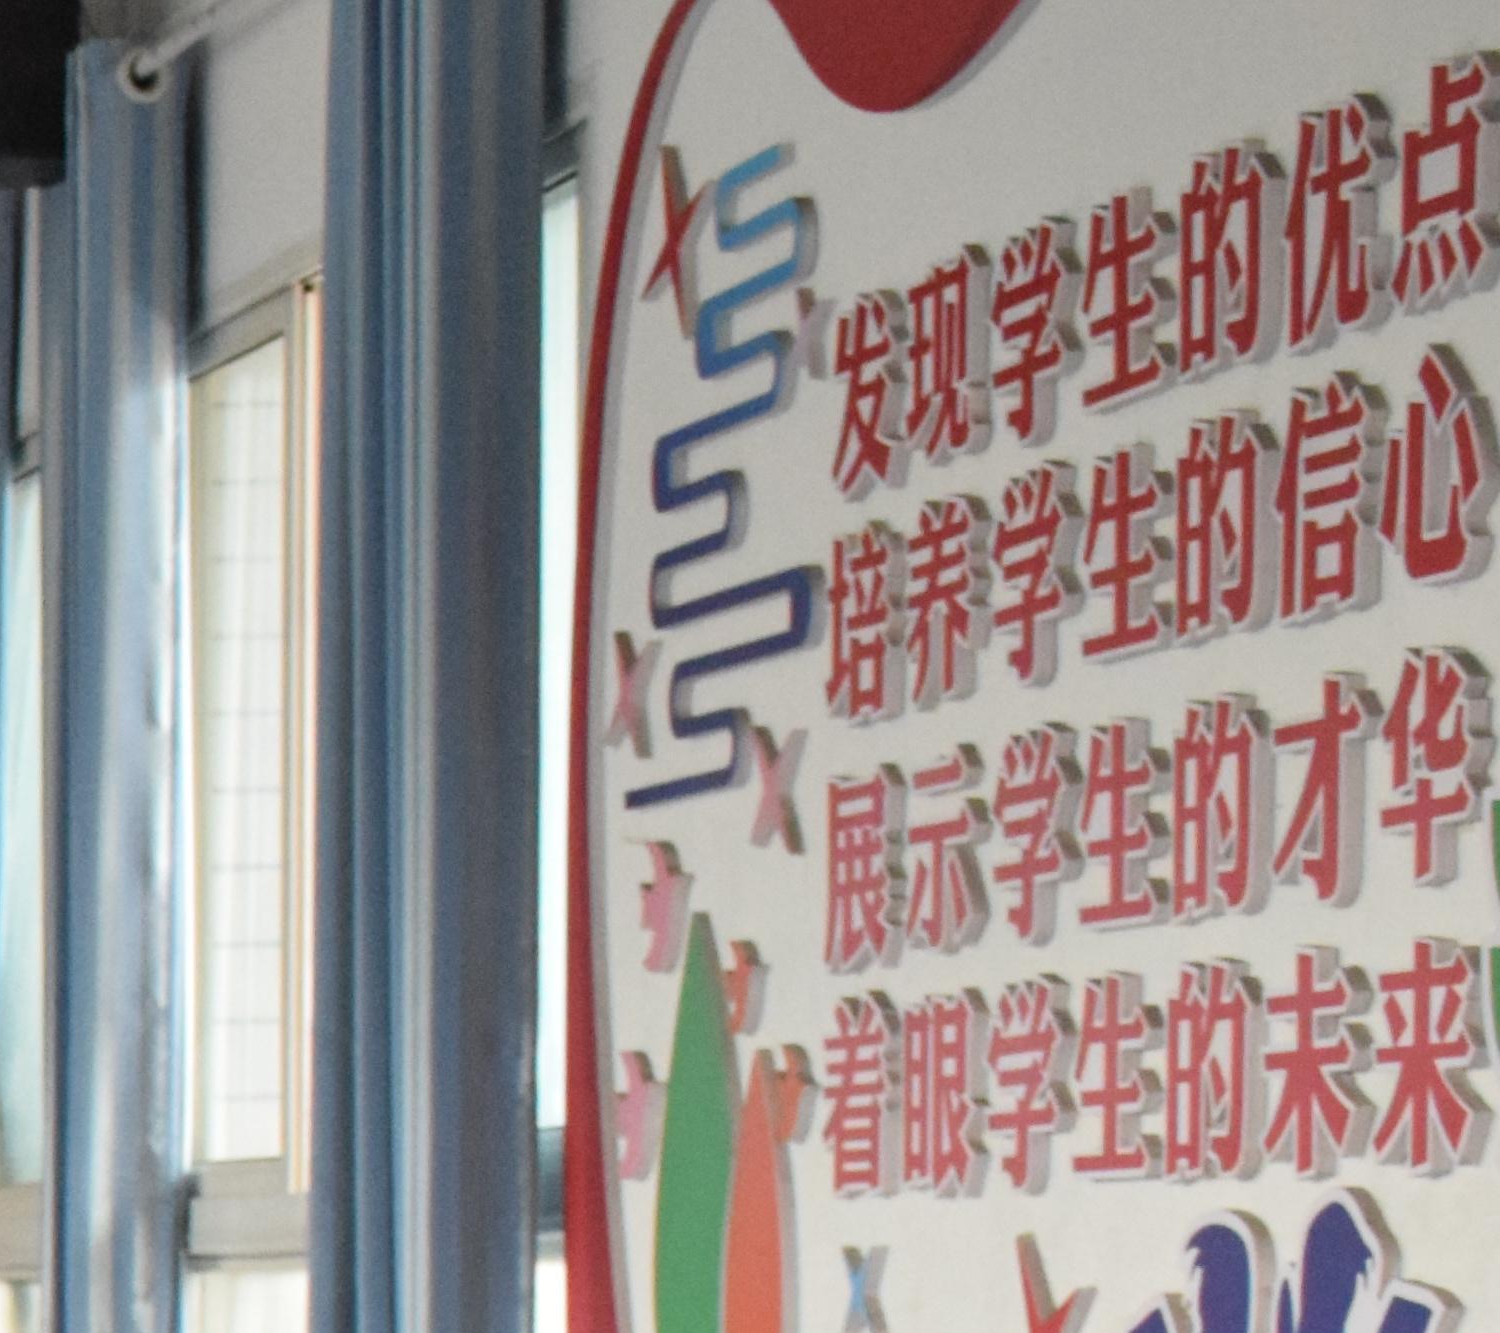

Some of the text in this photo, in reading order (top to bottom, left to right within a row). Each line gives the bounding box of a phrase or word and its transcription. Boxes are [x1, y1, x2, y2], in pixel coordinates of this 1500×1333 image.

[832, 58, 1490, 494] 发现学生的优点
[825, 350, 1488, 722] 培养学生的信心
[822, 650, 1474, 970] 展示学生的才华
[821, 938, 1474, 1195] 着眼学生的未来
